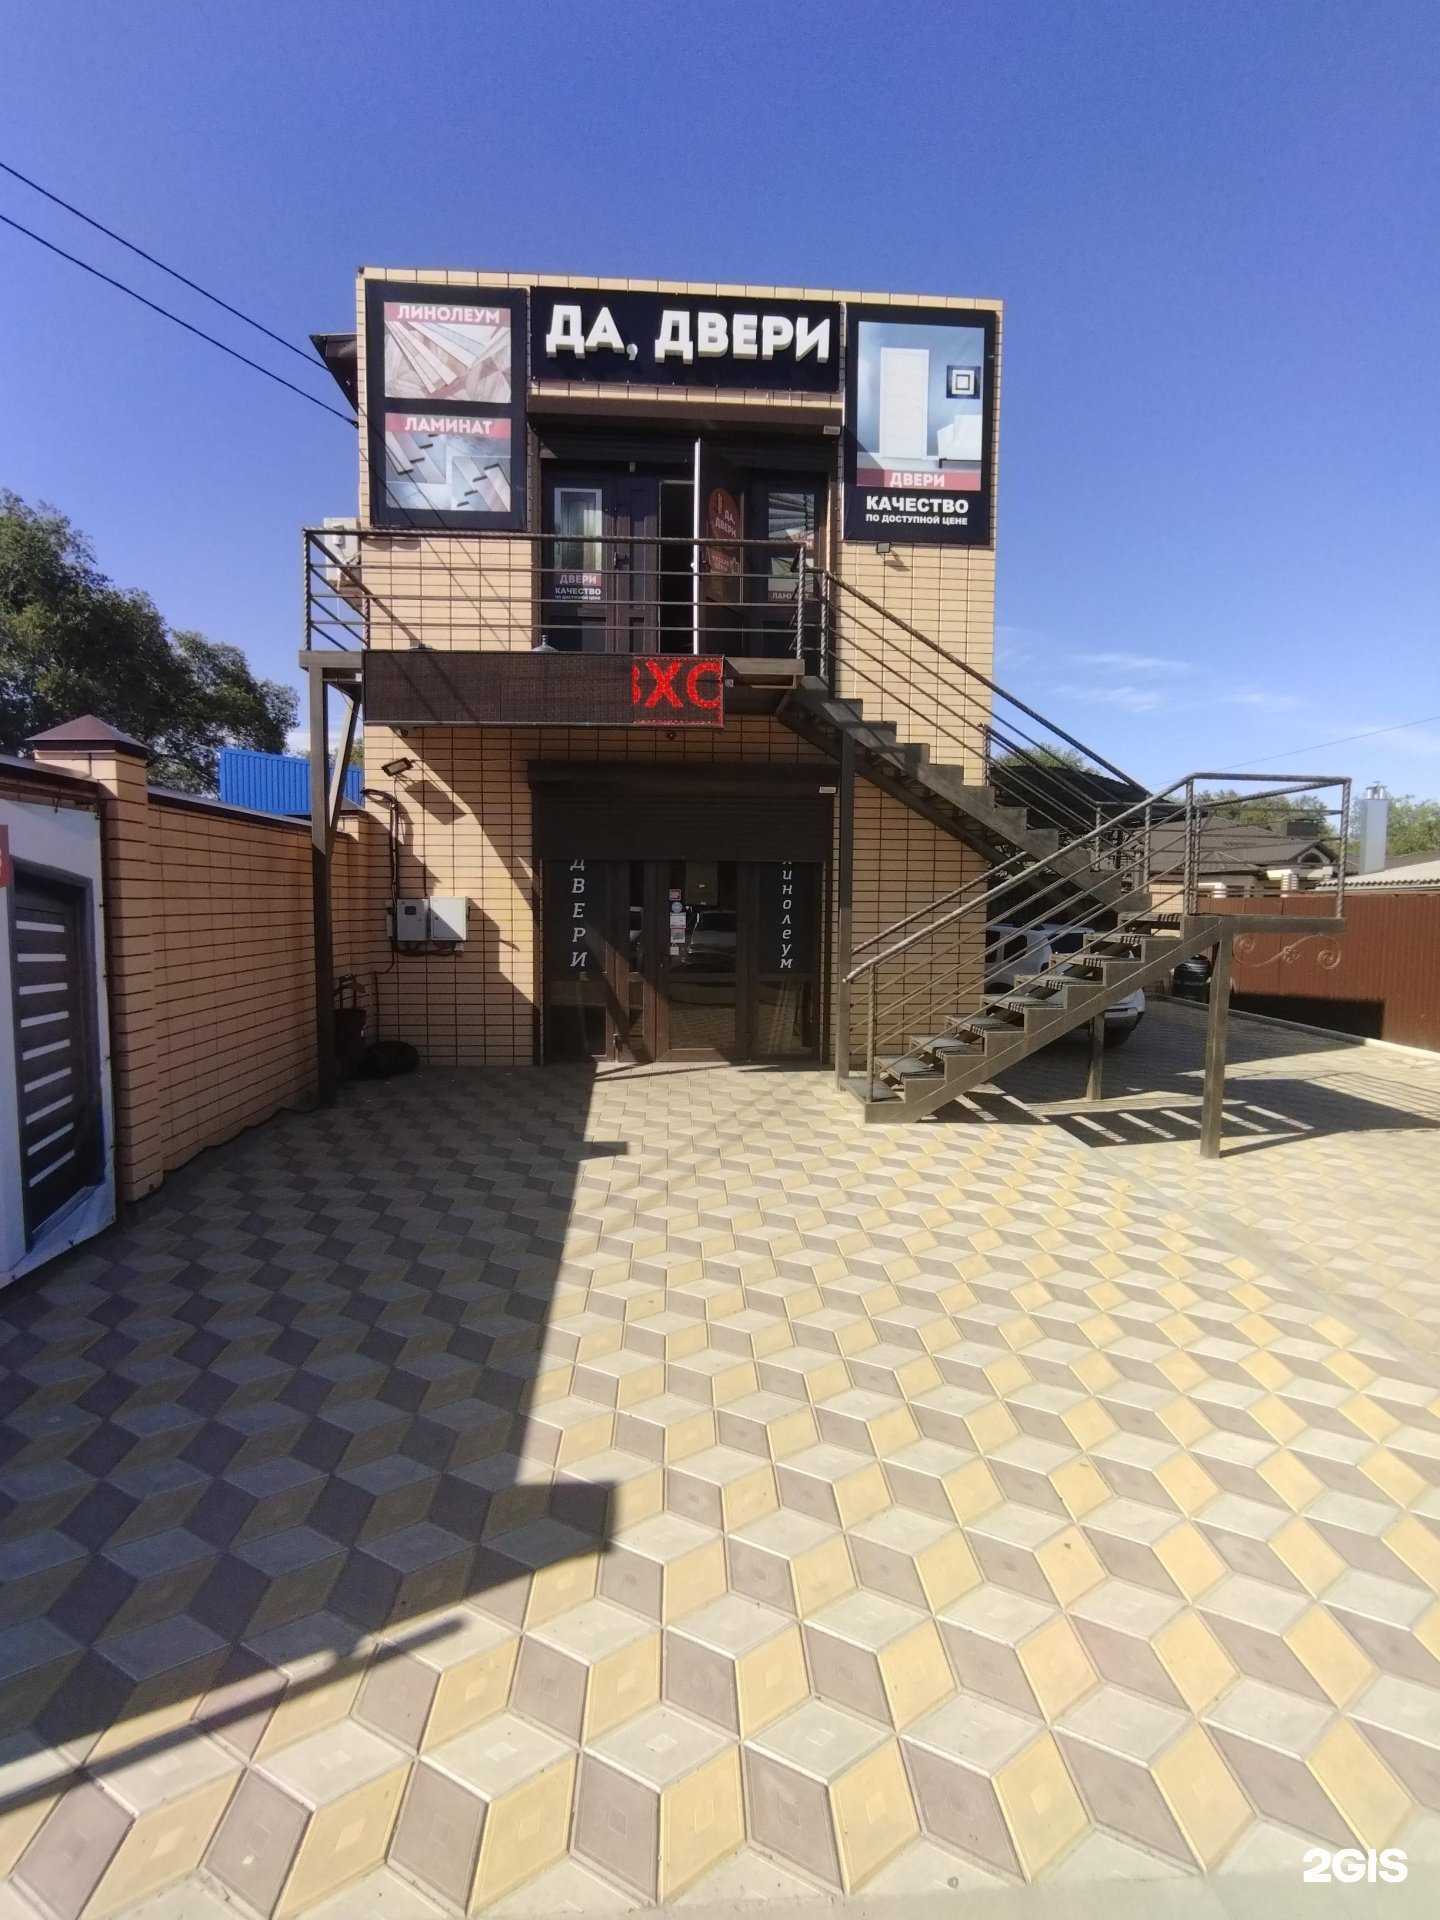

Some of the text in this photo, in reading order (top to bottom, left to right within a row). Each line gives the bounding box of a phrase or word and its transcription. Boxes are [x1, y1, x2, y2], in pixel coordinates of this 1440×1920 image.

[397, 305, 500, 324] ЛИНОЛЕУМ
[546, 304, 830, 365] ДА, ДВЕРИ
[404, 417, 493, 434] ЛАМИНАТ
[890, 472, 945, 488] ДВЕРИ
[866, 495, 969, 514] КАЧЕСТВО
[865, 513, 968, 526] ПО ДОСТУПНОЙ ЦЕНЕ
[560, 574, 597, 585] ДВЕРИ
[555, 587, 601, 596] КАЧЕСТВО
